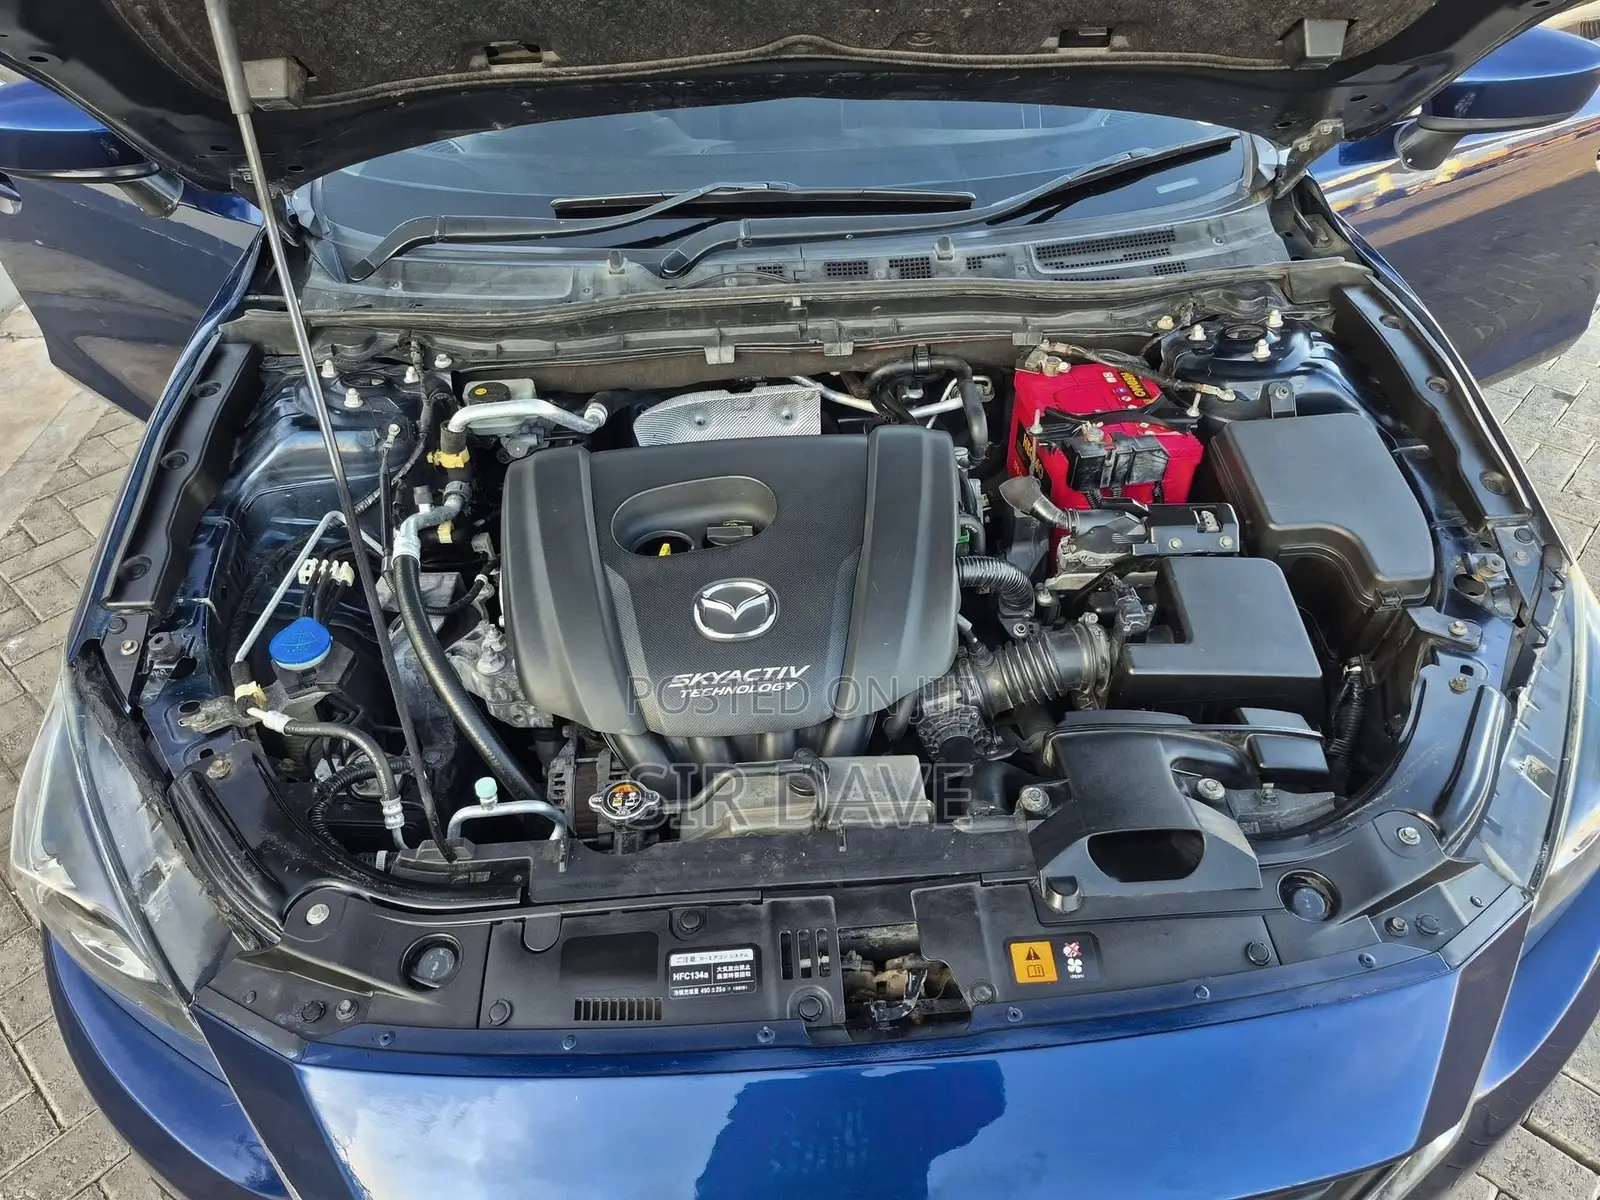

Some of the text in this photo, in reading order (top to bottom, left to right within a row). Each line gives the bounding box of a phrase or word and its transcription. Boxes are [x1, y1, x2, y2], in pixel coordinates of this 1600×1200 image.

[668, 665, 811, 688] SKYACTIV
[680, 681, 799, 699] TECHNOLOGY
[672, 970, 709, 981] HFC134a
